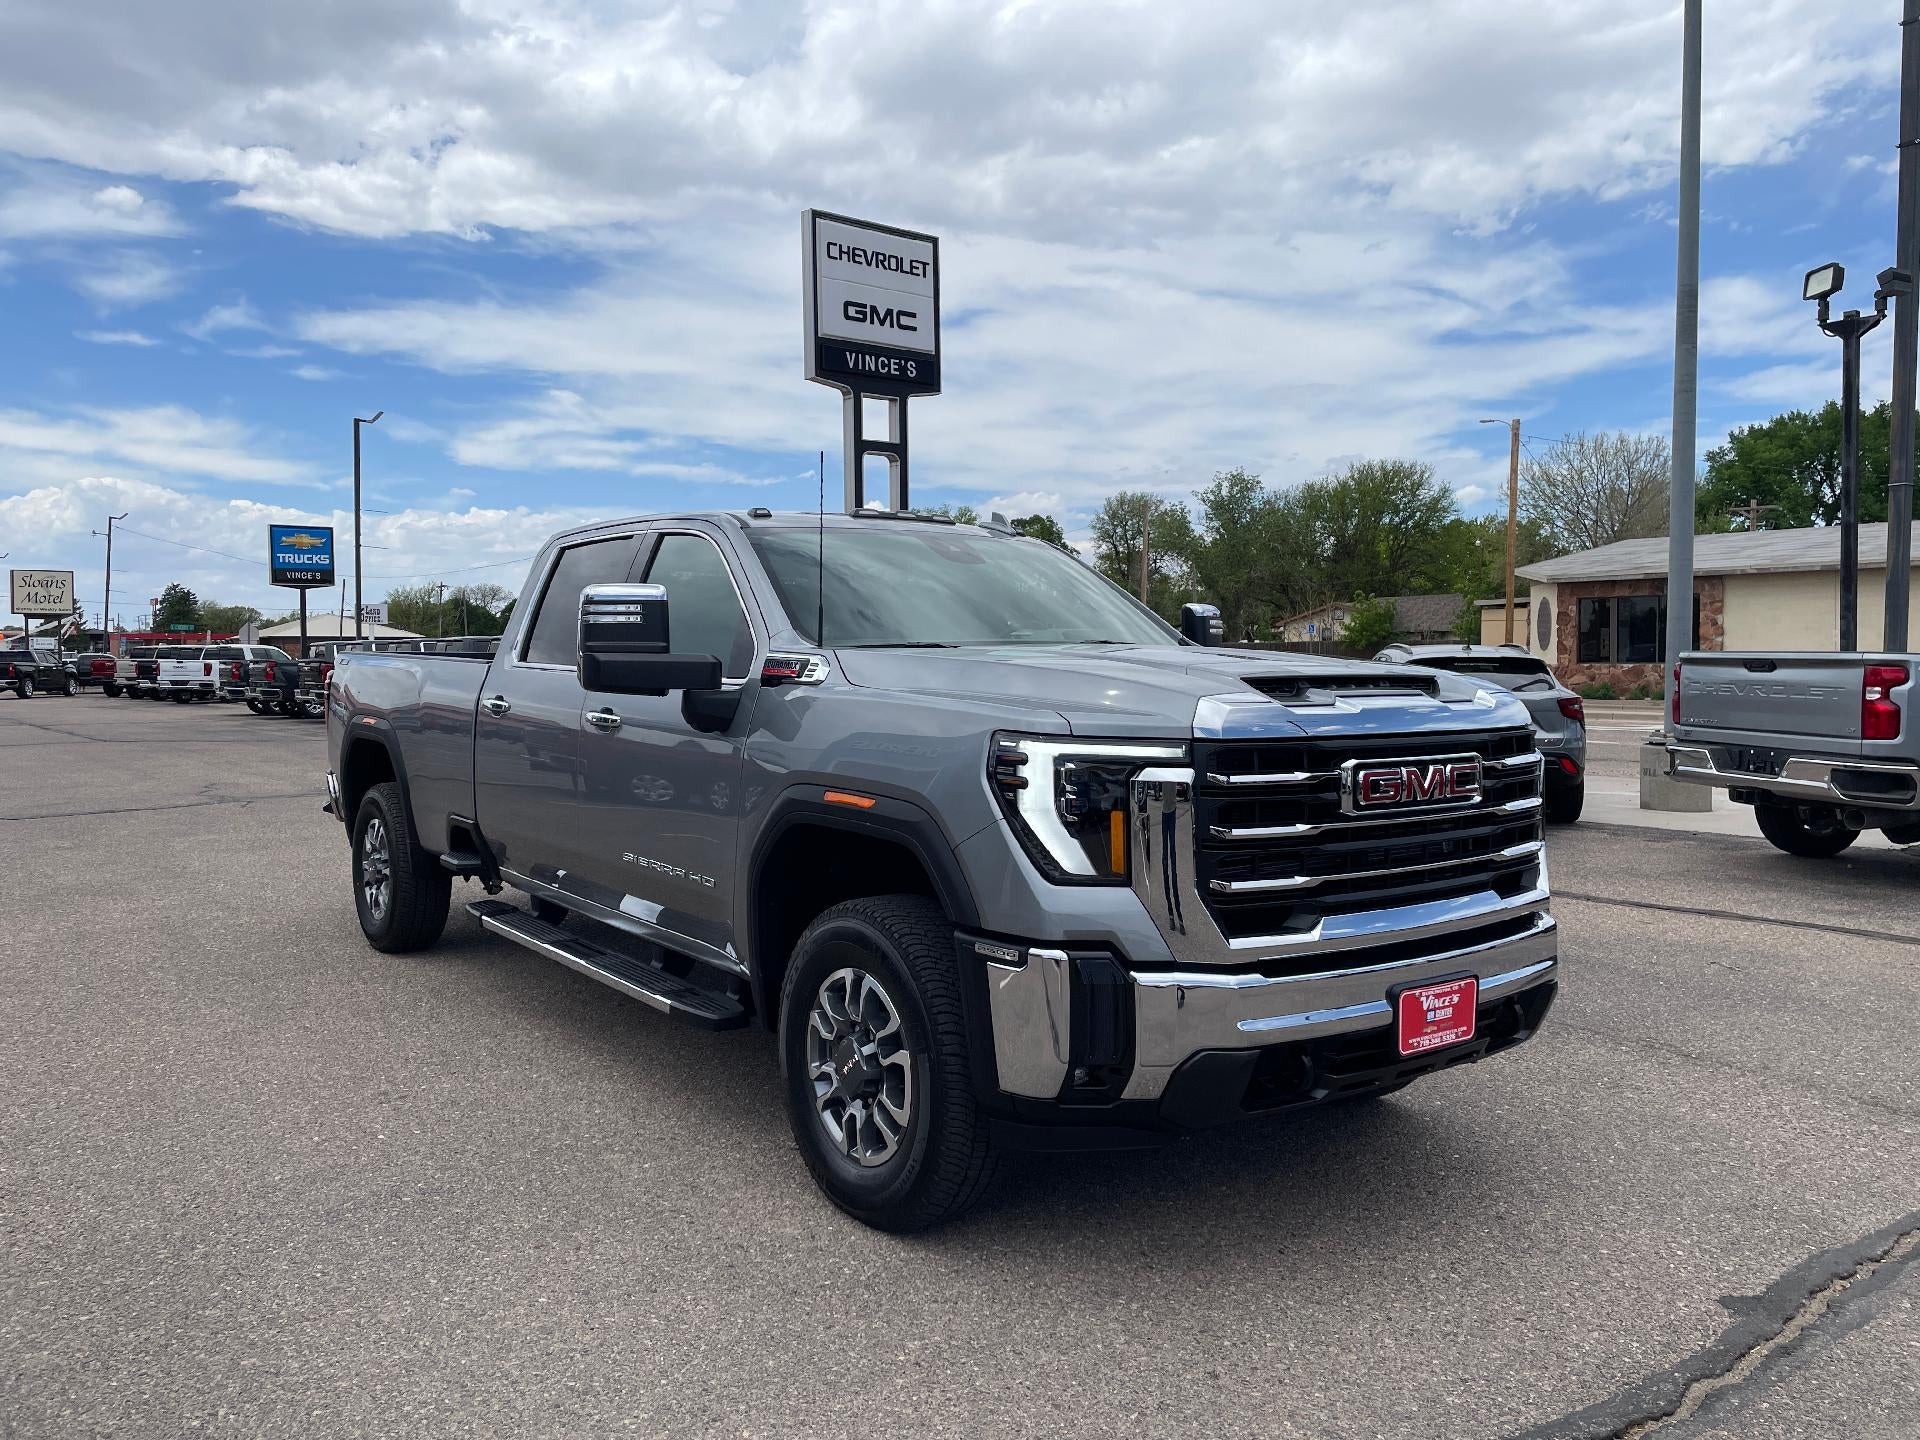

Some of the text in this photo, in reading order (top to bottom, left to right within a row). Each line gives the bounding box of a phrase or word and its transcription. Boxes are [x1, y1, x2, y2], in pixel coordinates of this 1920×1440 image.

[826, 241, 930, 278] CHEVROLET
[843, 300, 918, 332] GMC
[846, 351, 917, 378] VINCE'S
[276, 553, 330, 565] TRUCKS
[18, 574, 67, 590] Sloans
[286, 571, 321, 580] VINCE'S
[21, 591, 65, 604] Motel
[1687, 681, 1848, 701] CHEVROLET
[1358, 763, 1480, 805] GMC
[622, 852, 716, 888] SIERRA HD
